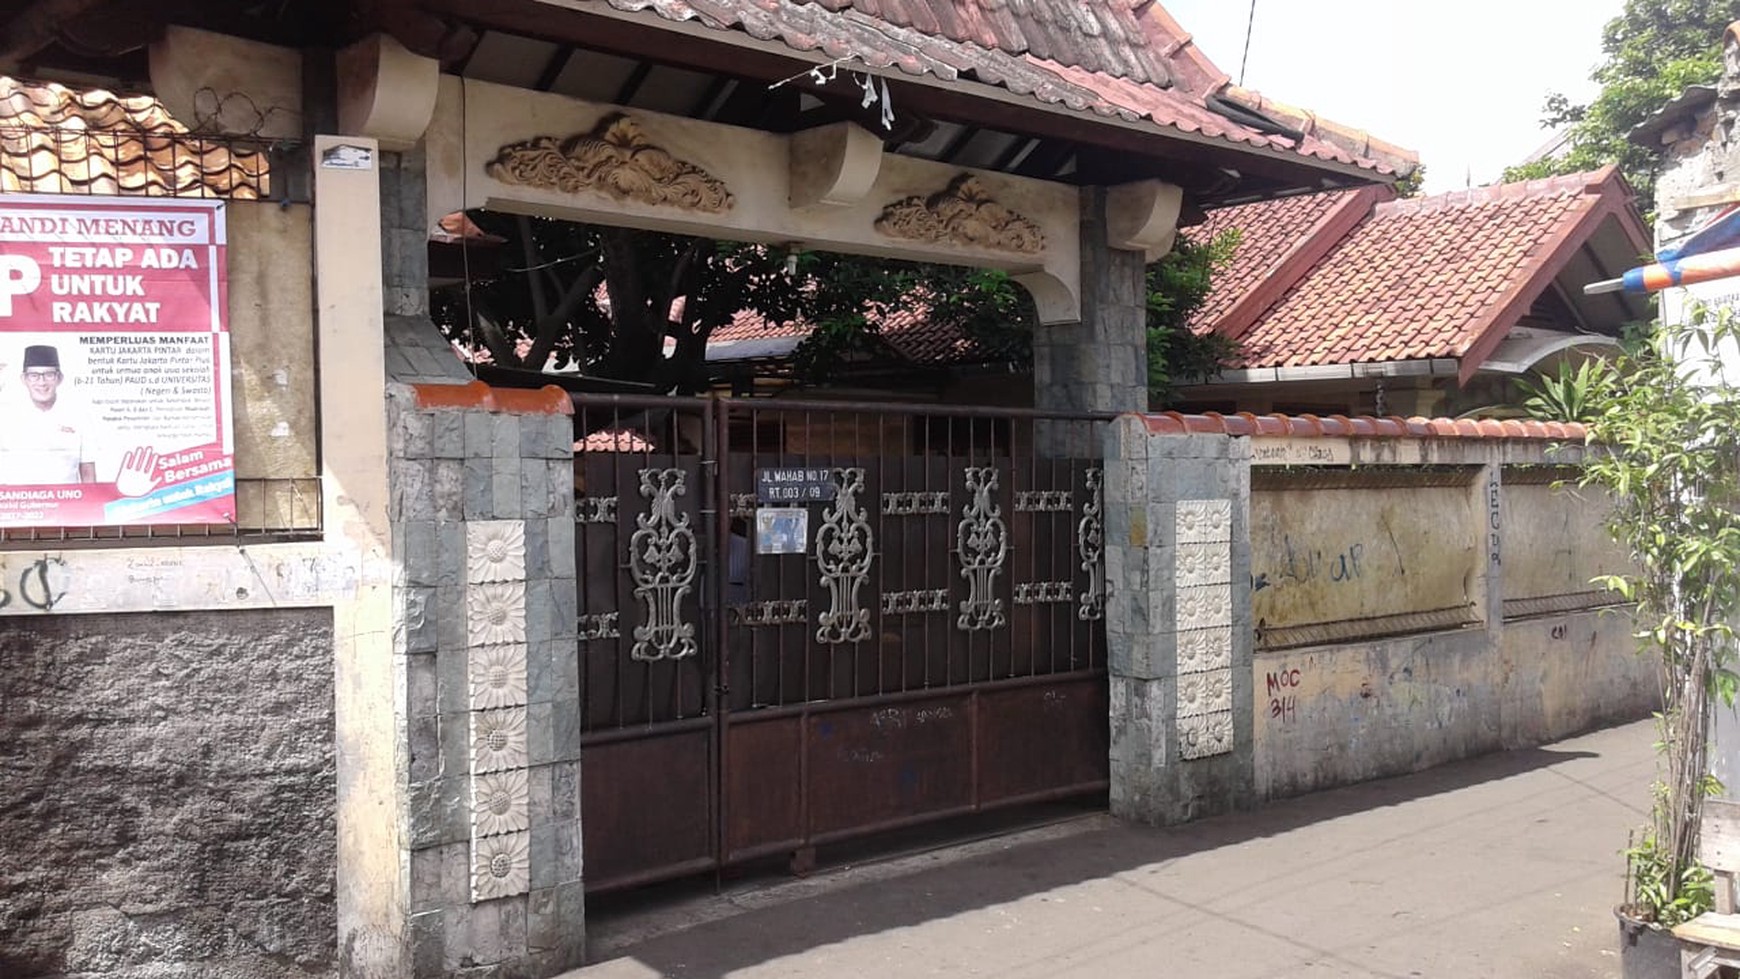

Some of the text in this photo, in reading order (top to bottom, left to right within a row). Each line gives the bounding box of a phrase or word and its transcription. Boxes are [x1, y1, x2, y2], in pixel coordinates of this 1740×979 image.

[76, 218, 196, 237] MENANG
[48, 247, 198, 269] TETAP ADA
[51, 274, 145, 296] UNTUK
[52, 302, 160, 323] RAKYAT
[79, 336, 209, 344] MEMPERLUAS MANFAAT
[159, 451, 204, 469] Salam
[164, 457, 232, 483] Bersama
[774, 470, 804, 482] WAHAB
[820, 469, 829, 481] 17
[57, 489, 82, 500] UNO
[809, 486, 820, 498] 09
